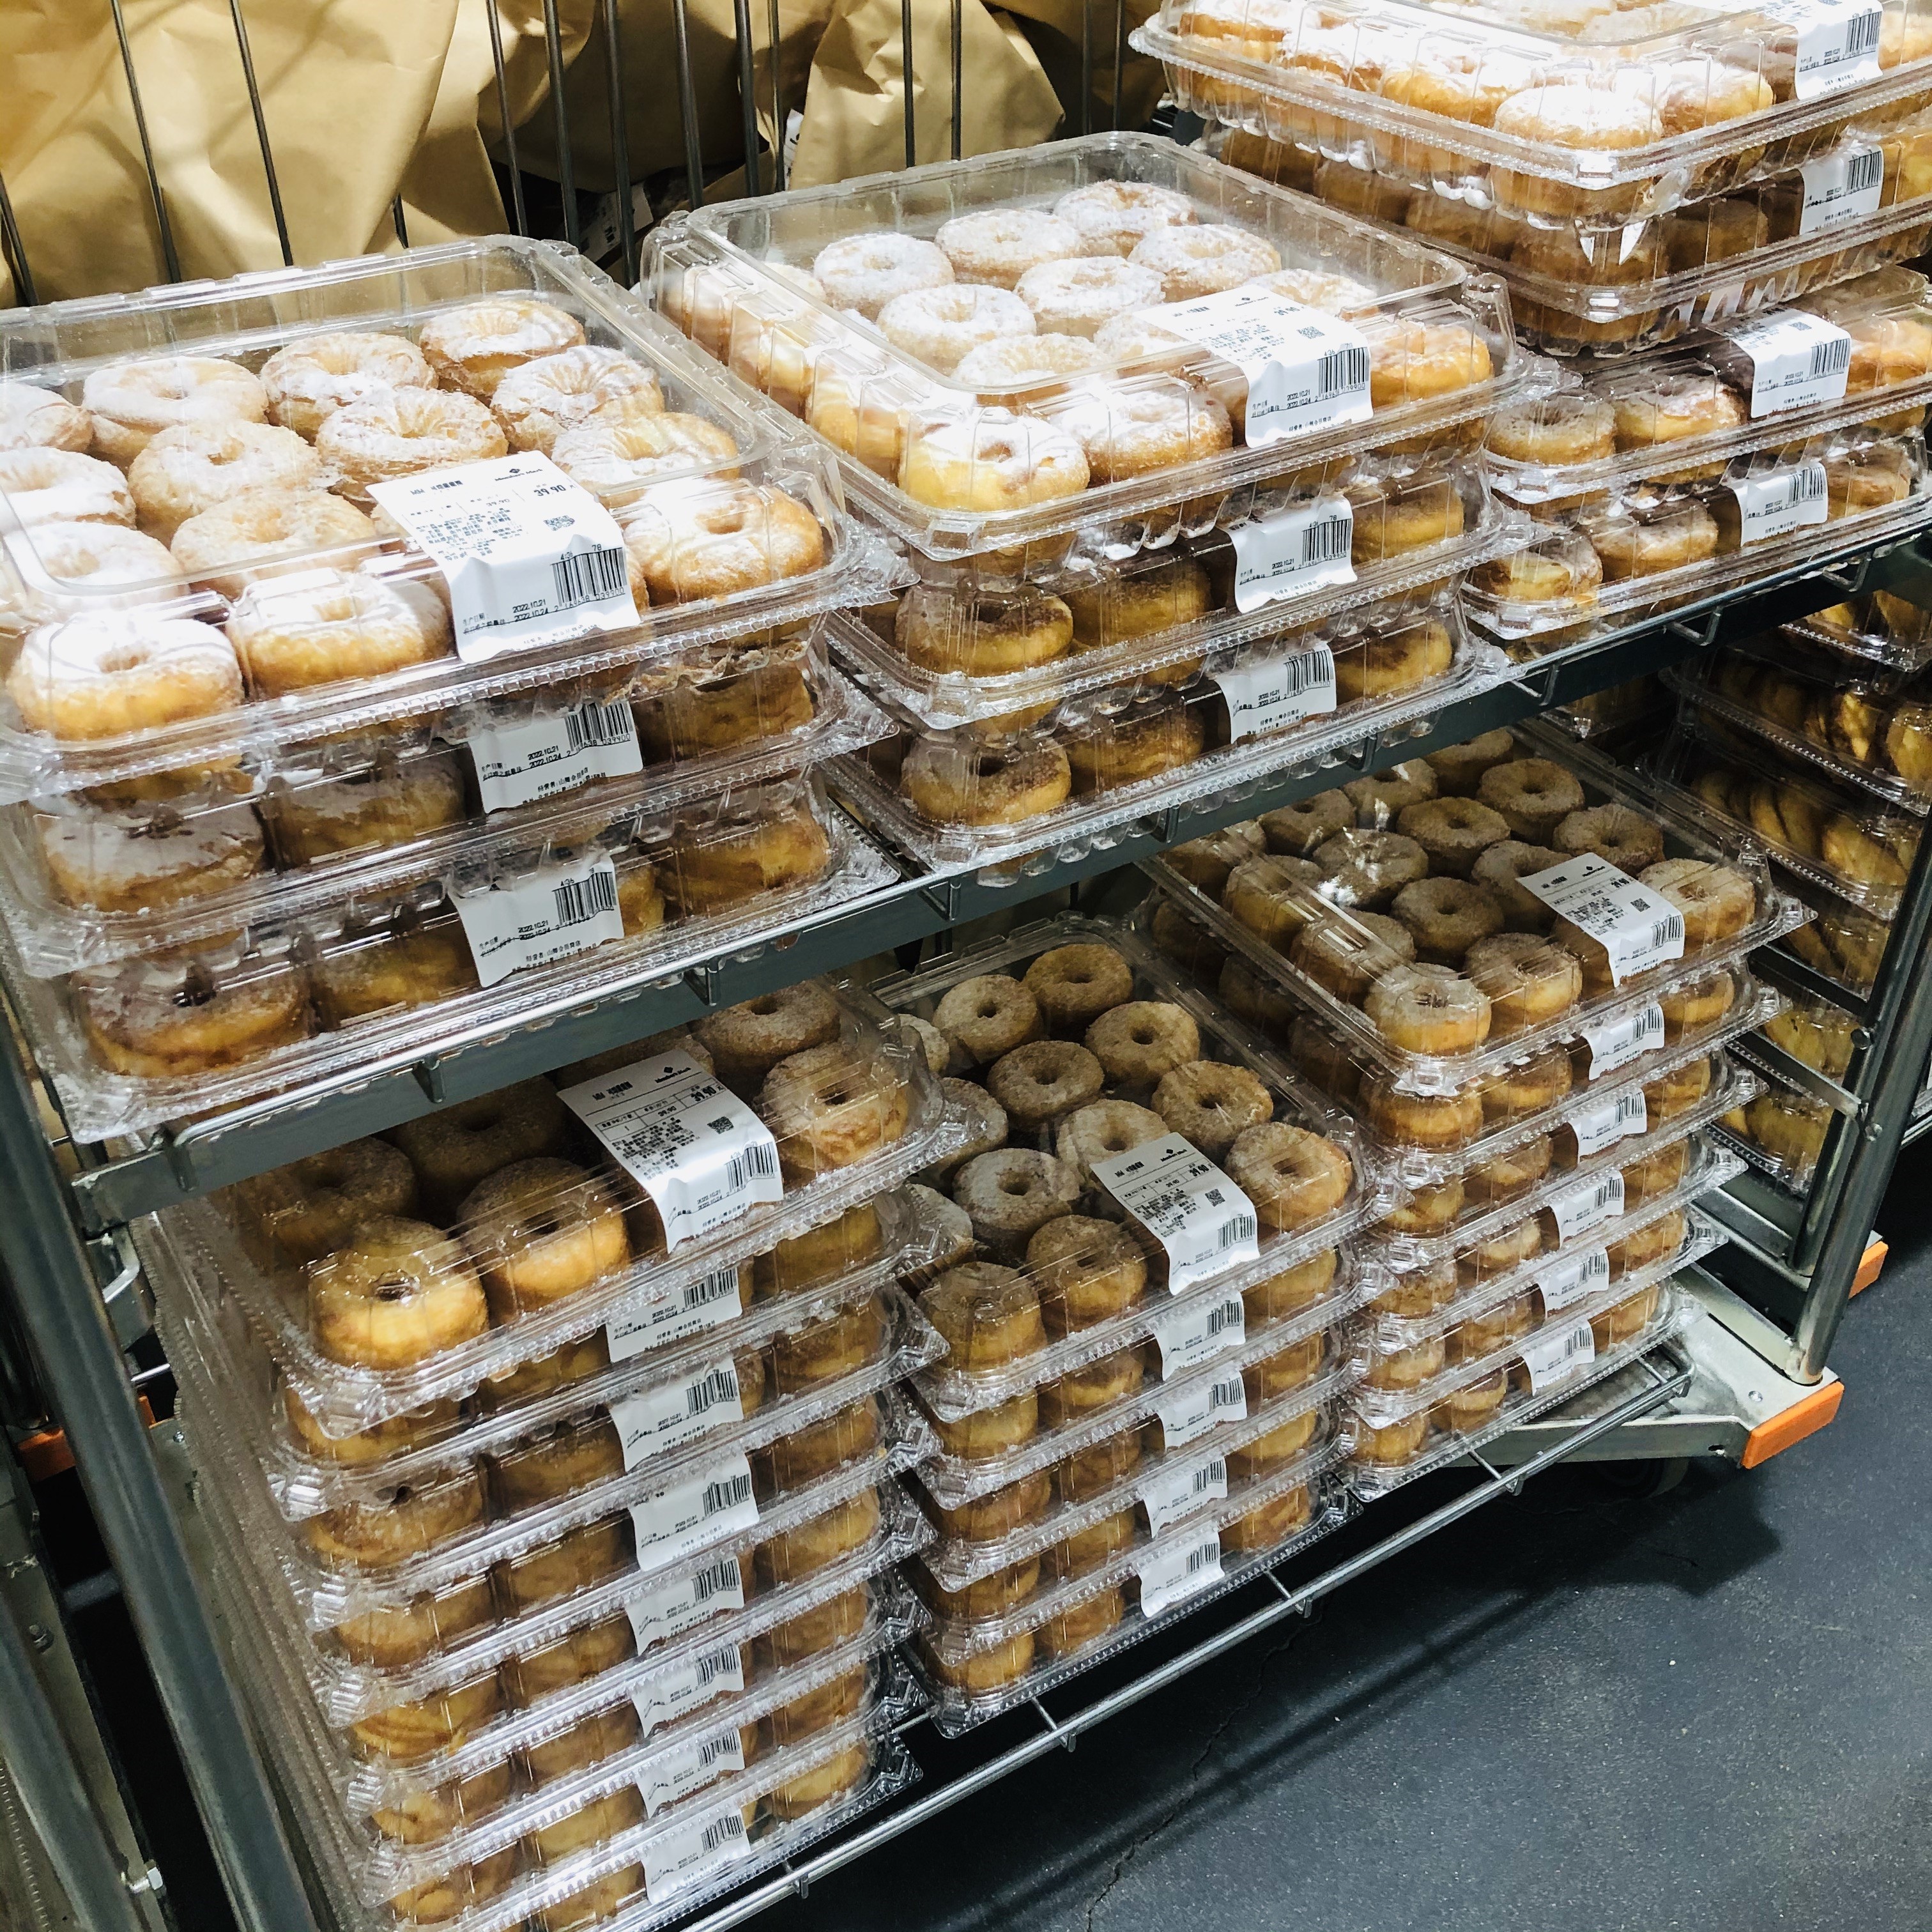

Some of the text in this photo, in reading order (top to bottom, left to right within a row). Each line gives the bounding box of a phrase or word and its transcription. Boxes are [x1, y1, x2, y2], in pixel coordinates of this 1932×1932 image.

[1287, 389, 1310, 401] 2022.10.21
[1287, 398, 1311, 410] 2022.10.24
[1271, 558, 1294, 570] 2022.10.21
[1271, 567, 1295, 577] 2022.10.24
[594, 586, 625, 602] 039900
[513, 599, 547, 613] 2022.10.21
[514, 608, 549, 623] 2022.10.24
[602, 733, 631, 746] 039900
[528, 745, 560, 760] 2022.10.21
[529, 753, 562, 769] 2022.10.24
[518, 919, 549, 933] 2022.10.21
[519, 927, 551, 941] 2022.10.24
[691, 1085, 717, 1102] 39.90
[657, 1105, 677, 1117] 39.90
[1189, 1163, 1209, 1177] 39.90
